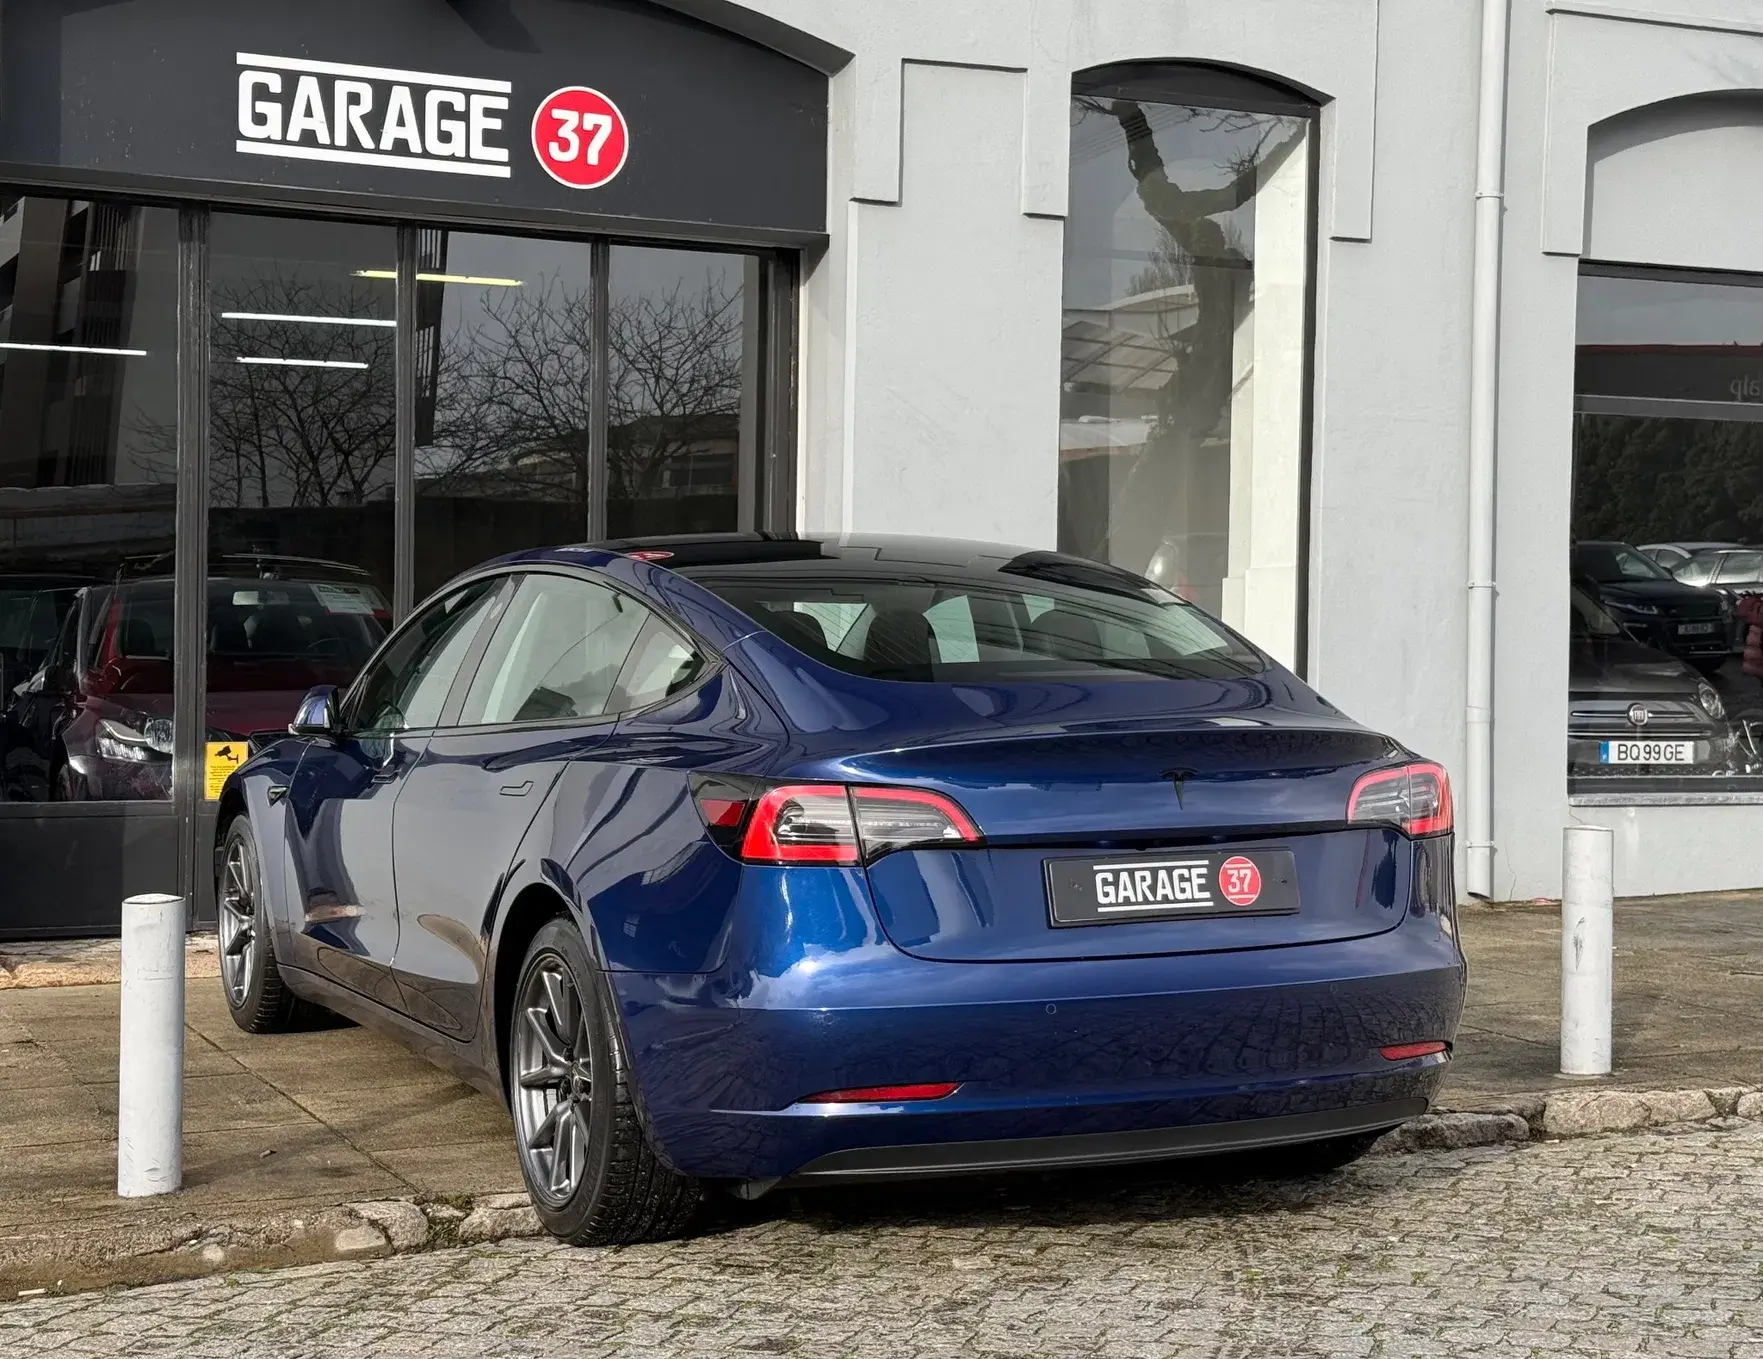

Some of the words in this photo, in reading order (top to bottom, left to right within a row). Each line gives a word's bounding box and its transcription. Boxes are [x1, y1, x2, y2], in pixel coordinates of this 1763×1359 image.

[238, 69, 510, 163] GARAGE
[548, 108, 613, 166] 37
[1094, 867, 1212, 905] GARAGE
[1226, 868, 1252, 893] 37
